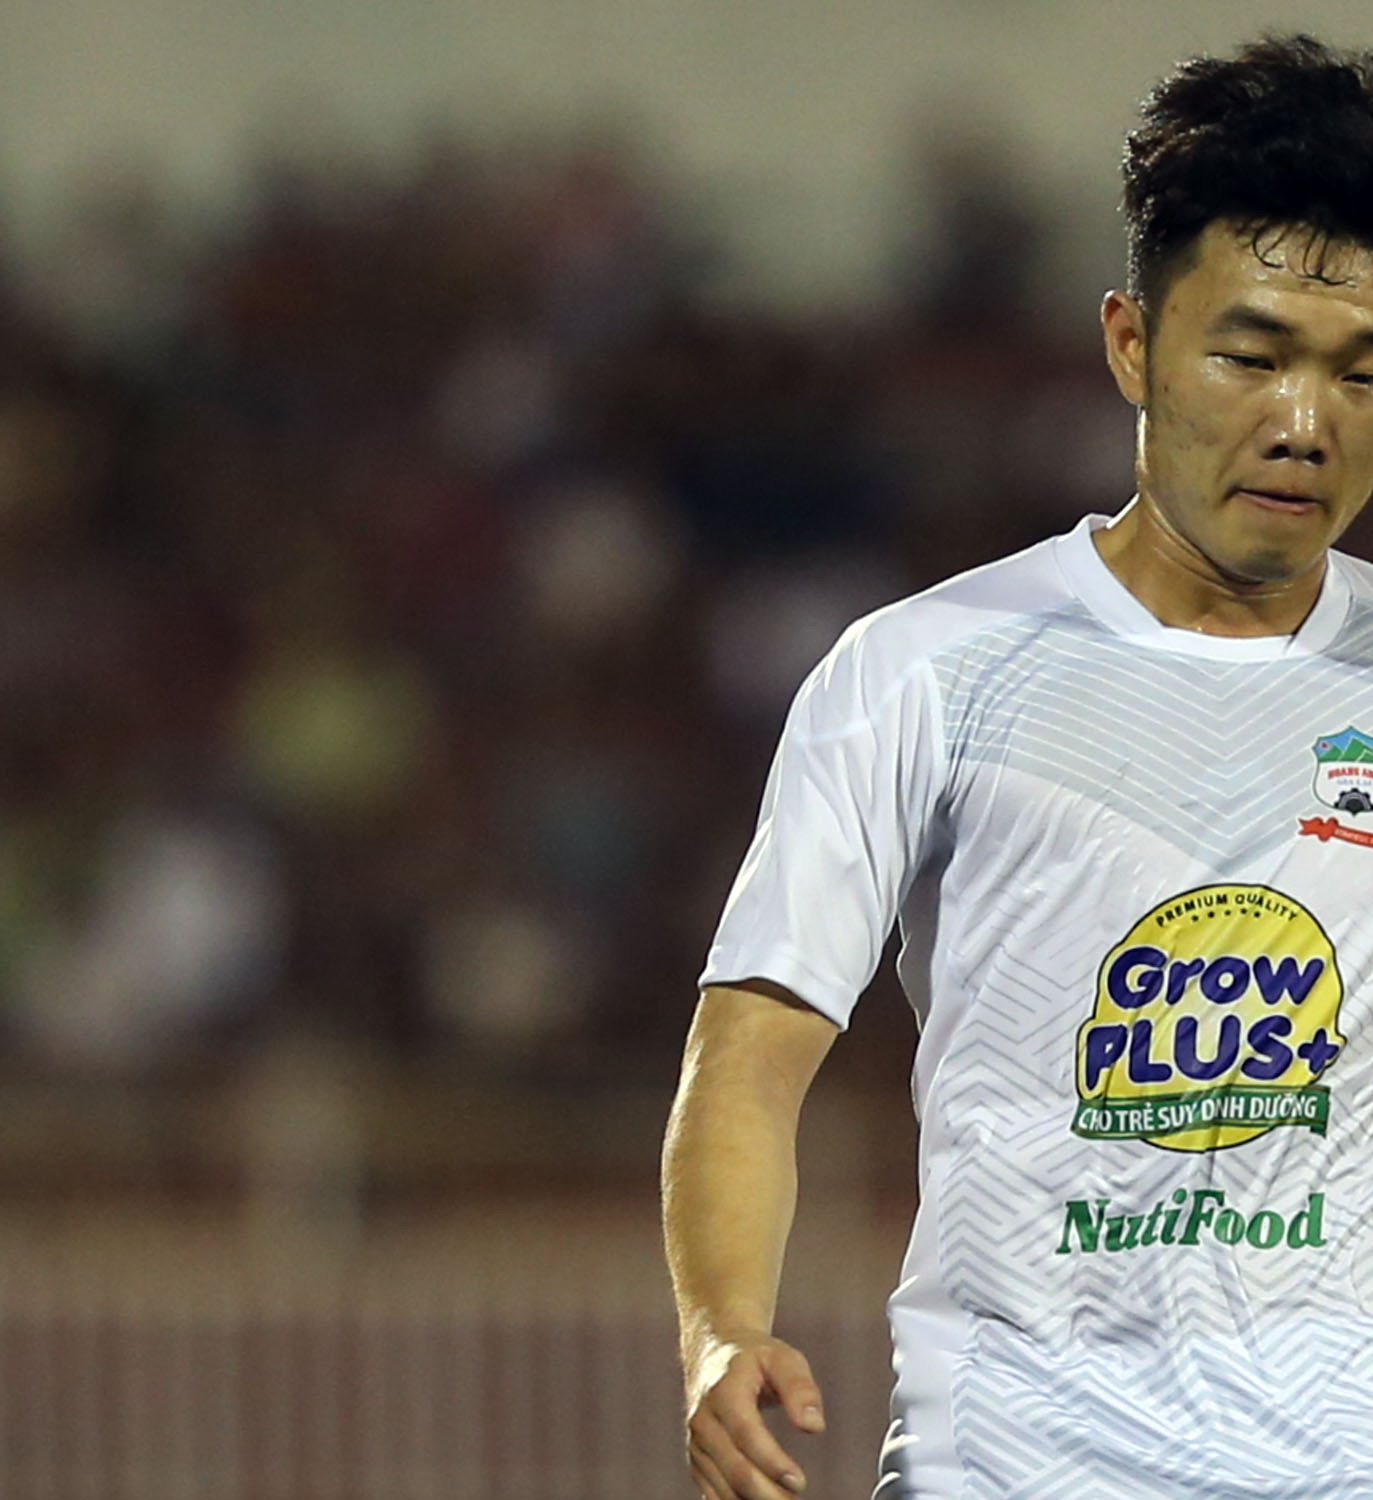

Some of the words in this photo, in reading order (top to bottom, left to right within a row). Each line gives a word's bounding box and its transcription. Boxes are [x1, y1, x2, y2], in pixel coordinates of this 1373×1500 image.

[1156, 894, 1228, 927] PREMIUM
[1235, 894, 1298, 921] QUALITY
[1107, 946, 1325, 1010] Grow
[1085, 1014, 1341, 1091] PLUS+
[1078, 1107, 1113, 1131] CHO
[1157, 1101, 1199, 1130] SUY
[1201, 1096, 1244, 1121] DNH
[1055, 1188, 1328, 1255] NutiFood
